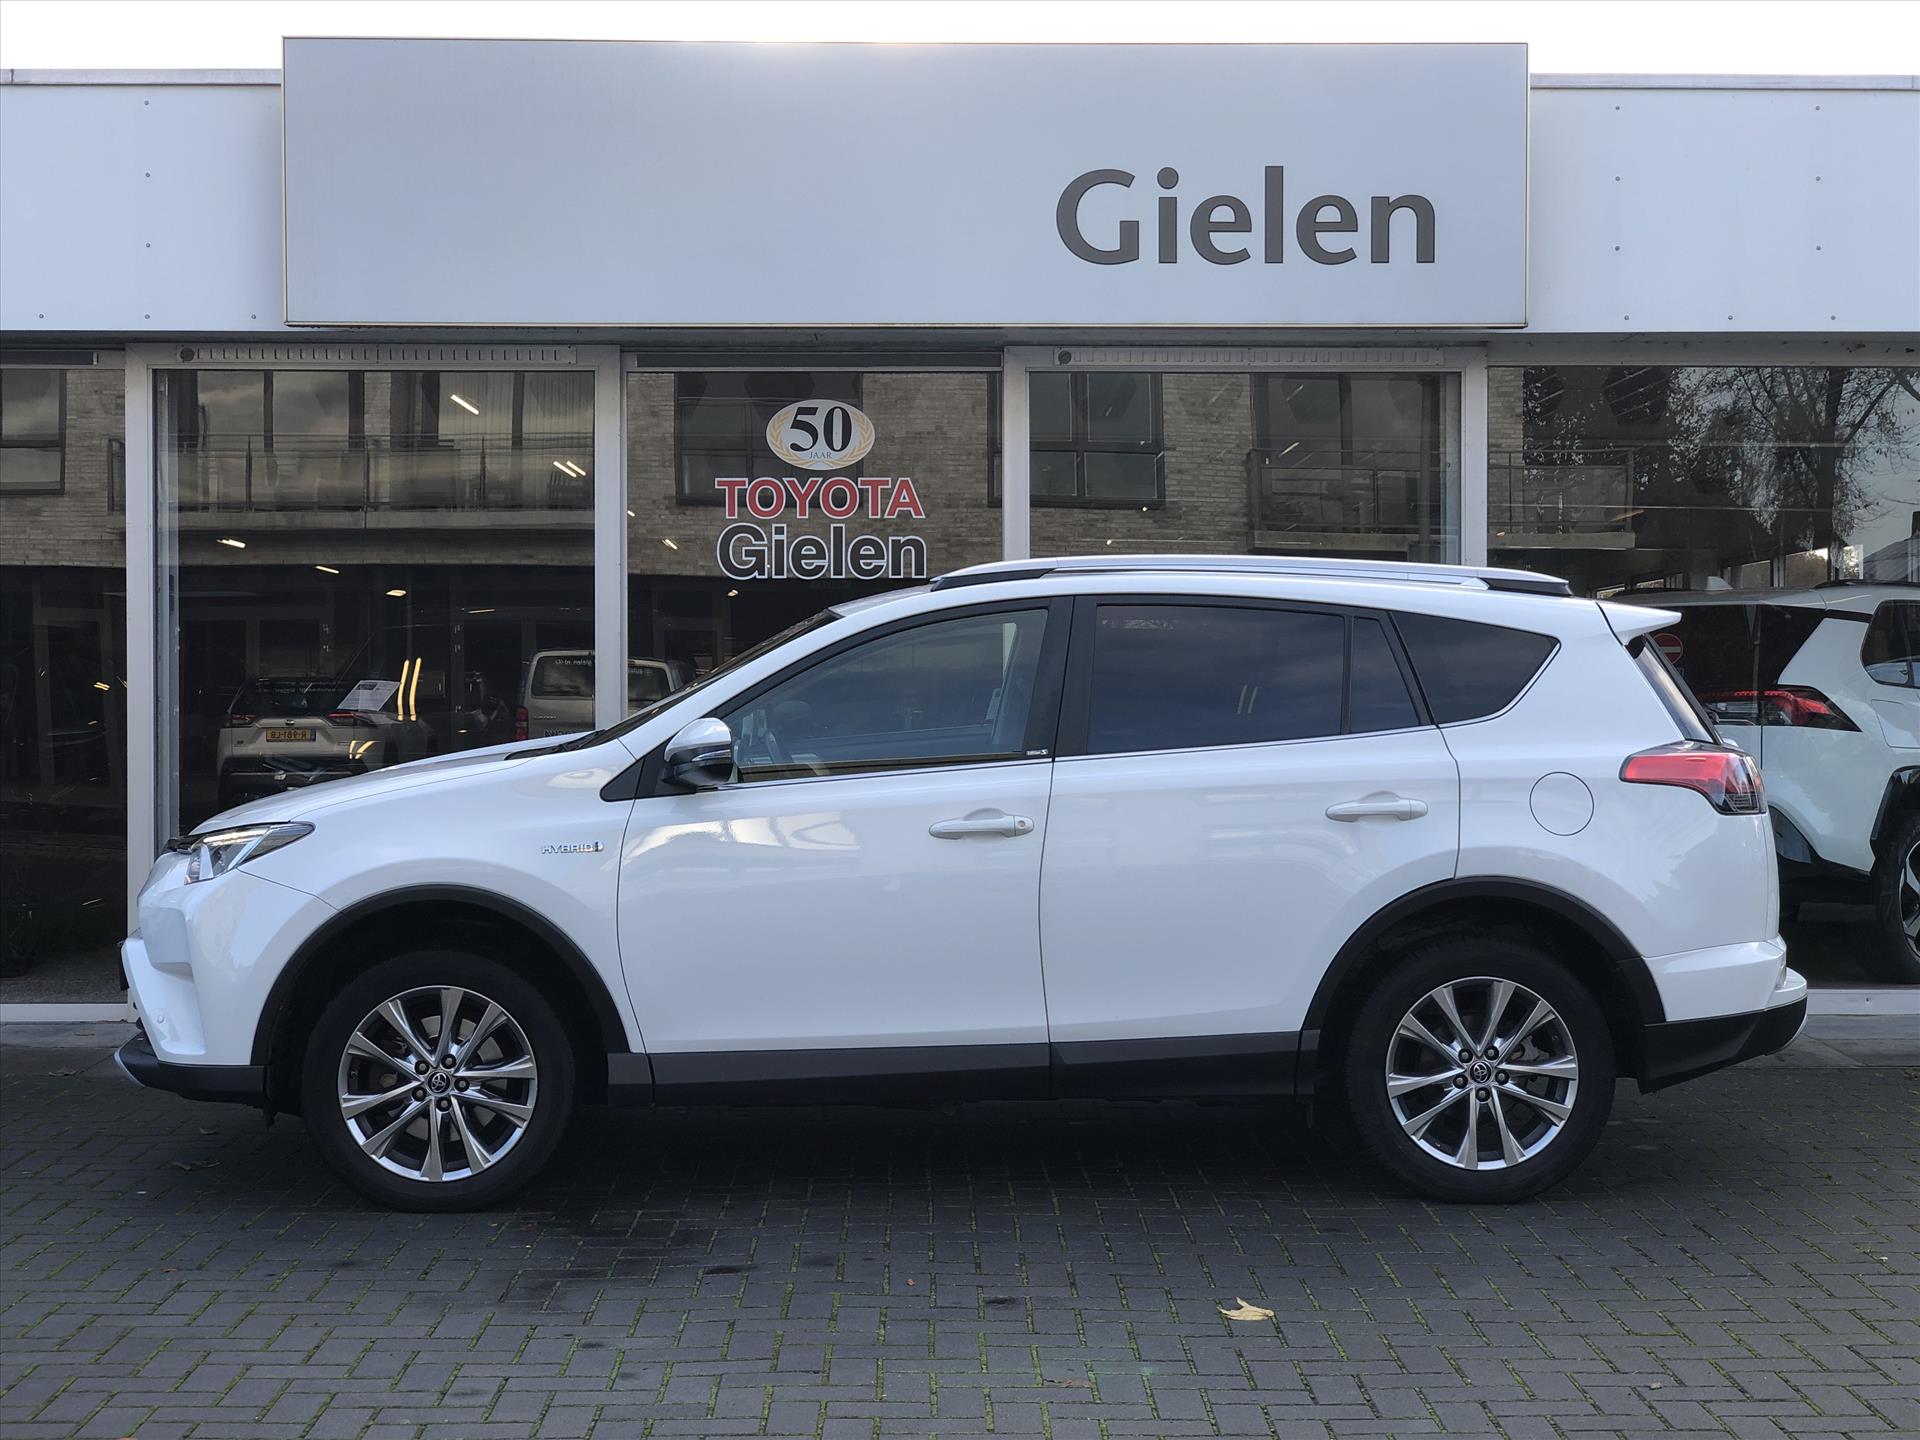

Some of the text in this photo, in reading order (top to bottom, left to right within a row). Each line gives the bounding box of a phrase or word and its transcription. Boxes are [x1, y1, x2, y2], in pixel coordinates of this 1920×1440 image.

[1056, 165, 1436, 265] Gielen
[790, 406, 852, 452] 50
[808, 451, 833, 459] JAAR
[715, 477, 925, 519] TOYOTA
[717, 522, 927, 580] Gielen
[541, 844, 593, 854] HYBRID
